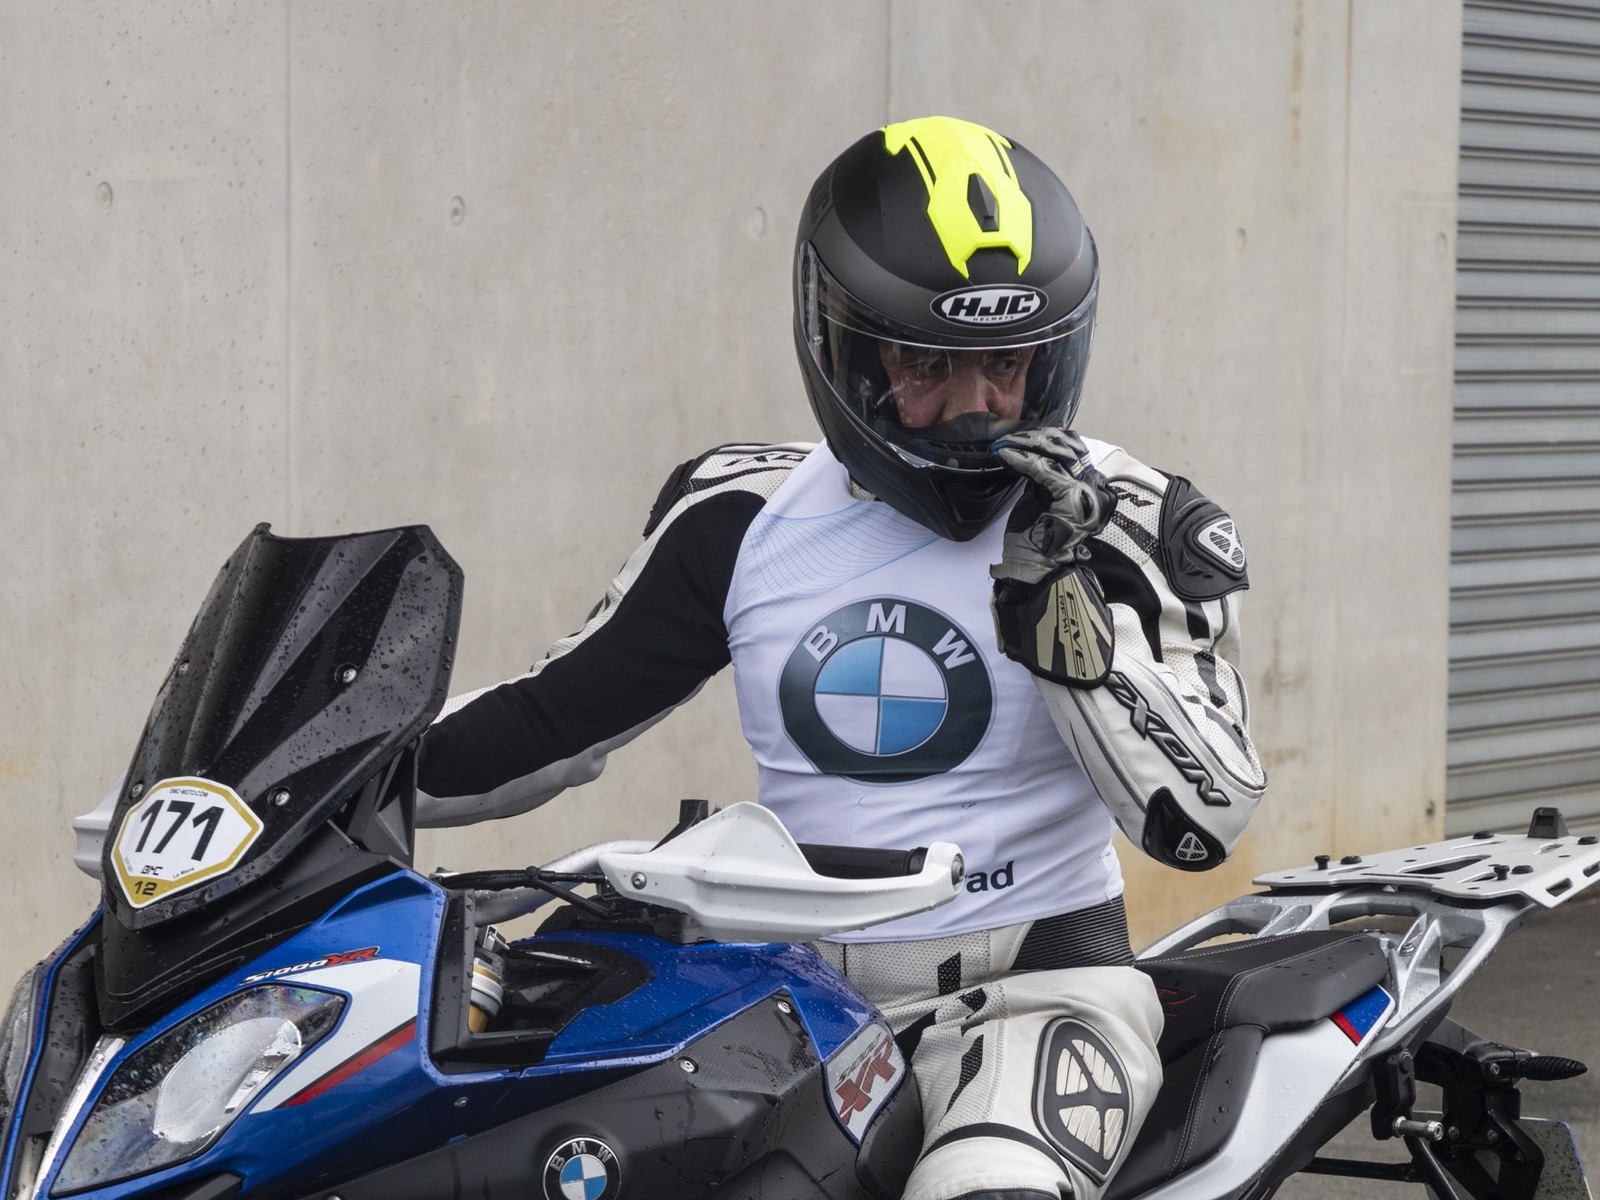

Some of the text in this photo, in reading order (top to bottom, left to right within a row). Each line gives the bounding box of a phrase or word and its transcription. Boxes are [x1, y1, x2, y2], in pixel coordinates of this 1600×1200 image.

[948, 293, 1035, 316] HJC
[802, 602, 976, 670] BMW
[135, 799, 225, 862] 171
[134, 880, 158, 896] 12
[549, 1140, 612, 1172] BMW
